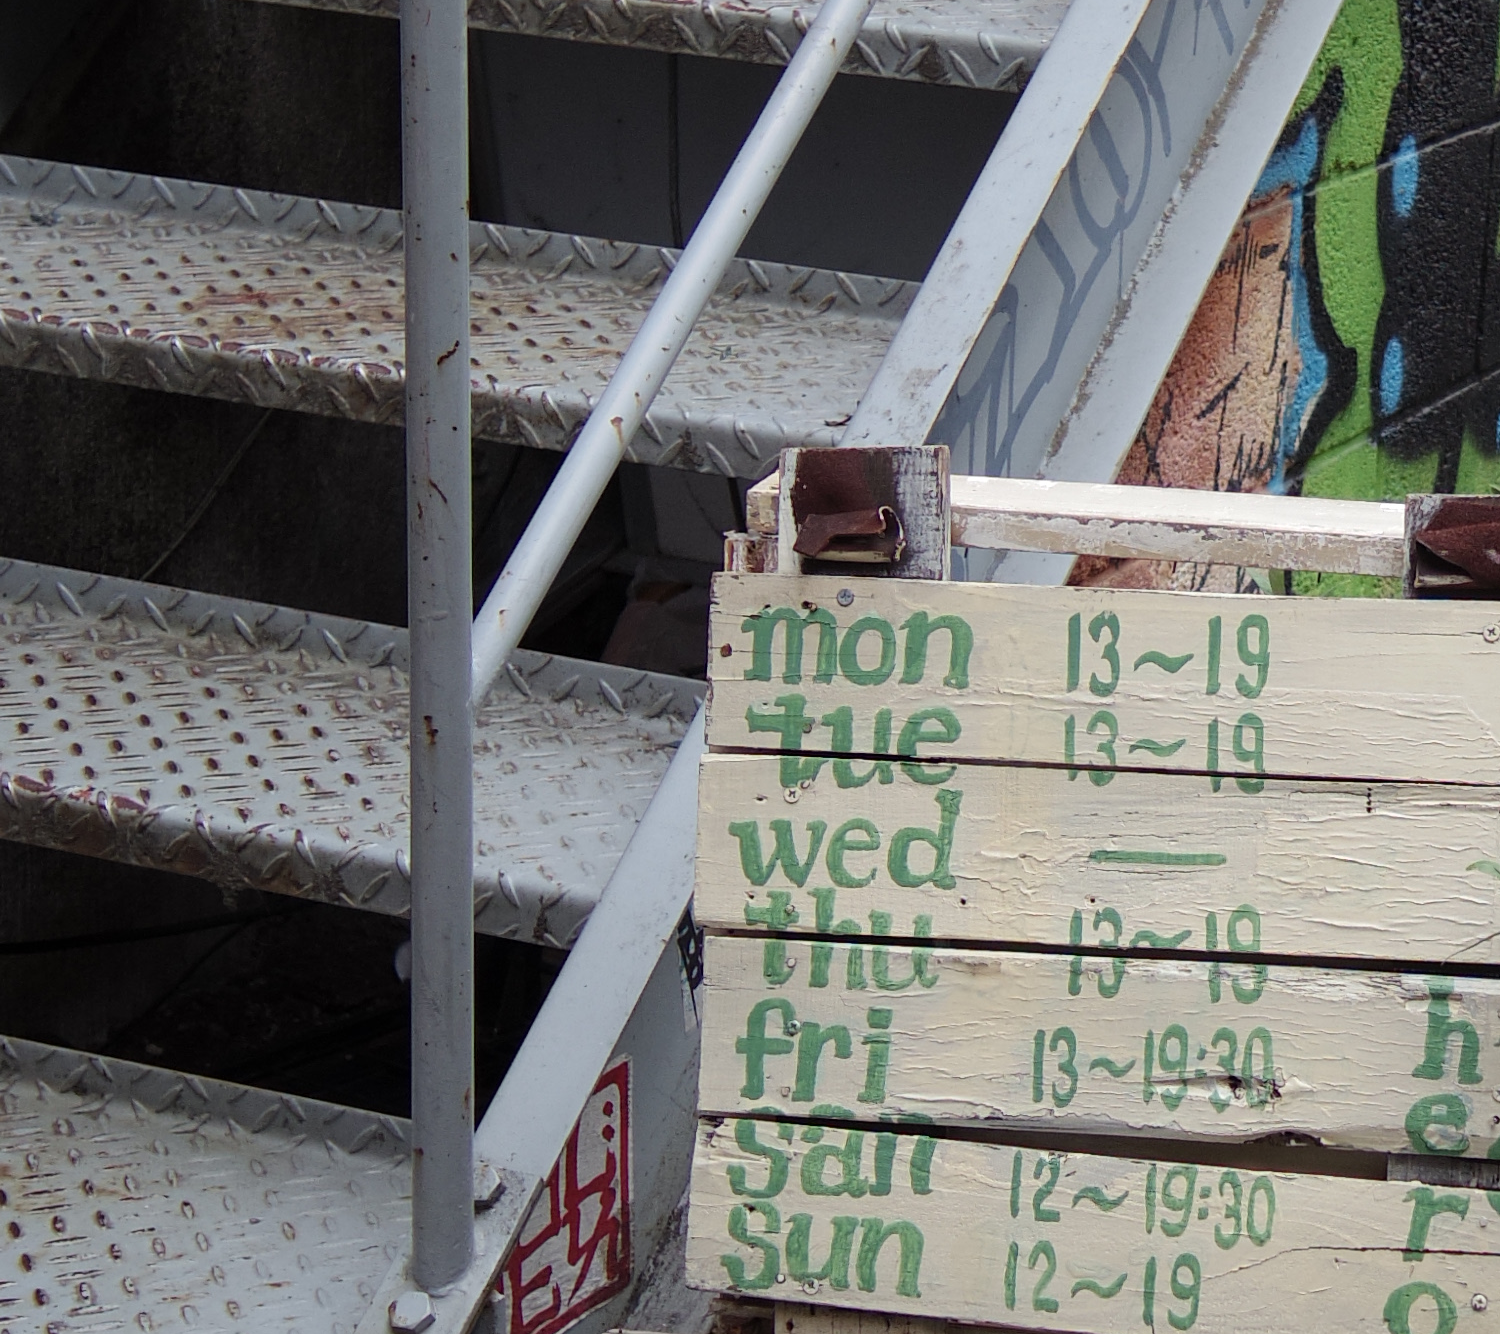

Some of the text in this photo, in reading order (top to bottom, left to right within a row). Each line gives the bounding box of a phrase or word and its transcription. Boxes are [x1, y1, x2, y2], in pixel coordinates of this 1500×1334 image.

[741, 606, 974, 690] mon
[745, 693, 962, 790] tue
[728, 787, 964, 890] wed
[744, 887, 940, 991] thu
[736, 997, 893, 1104] fri
